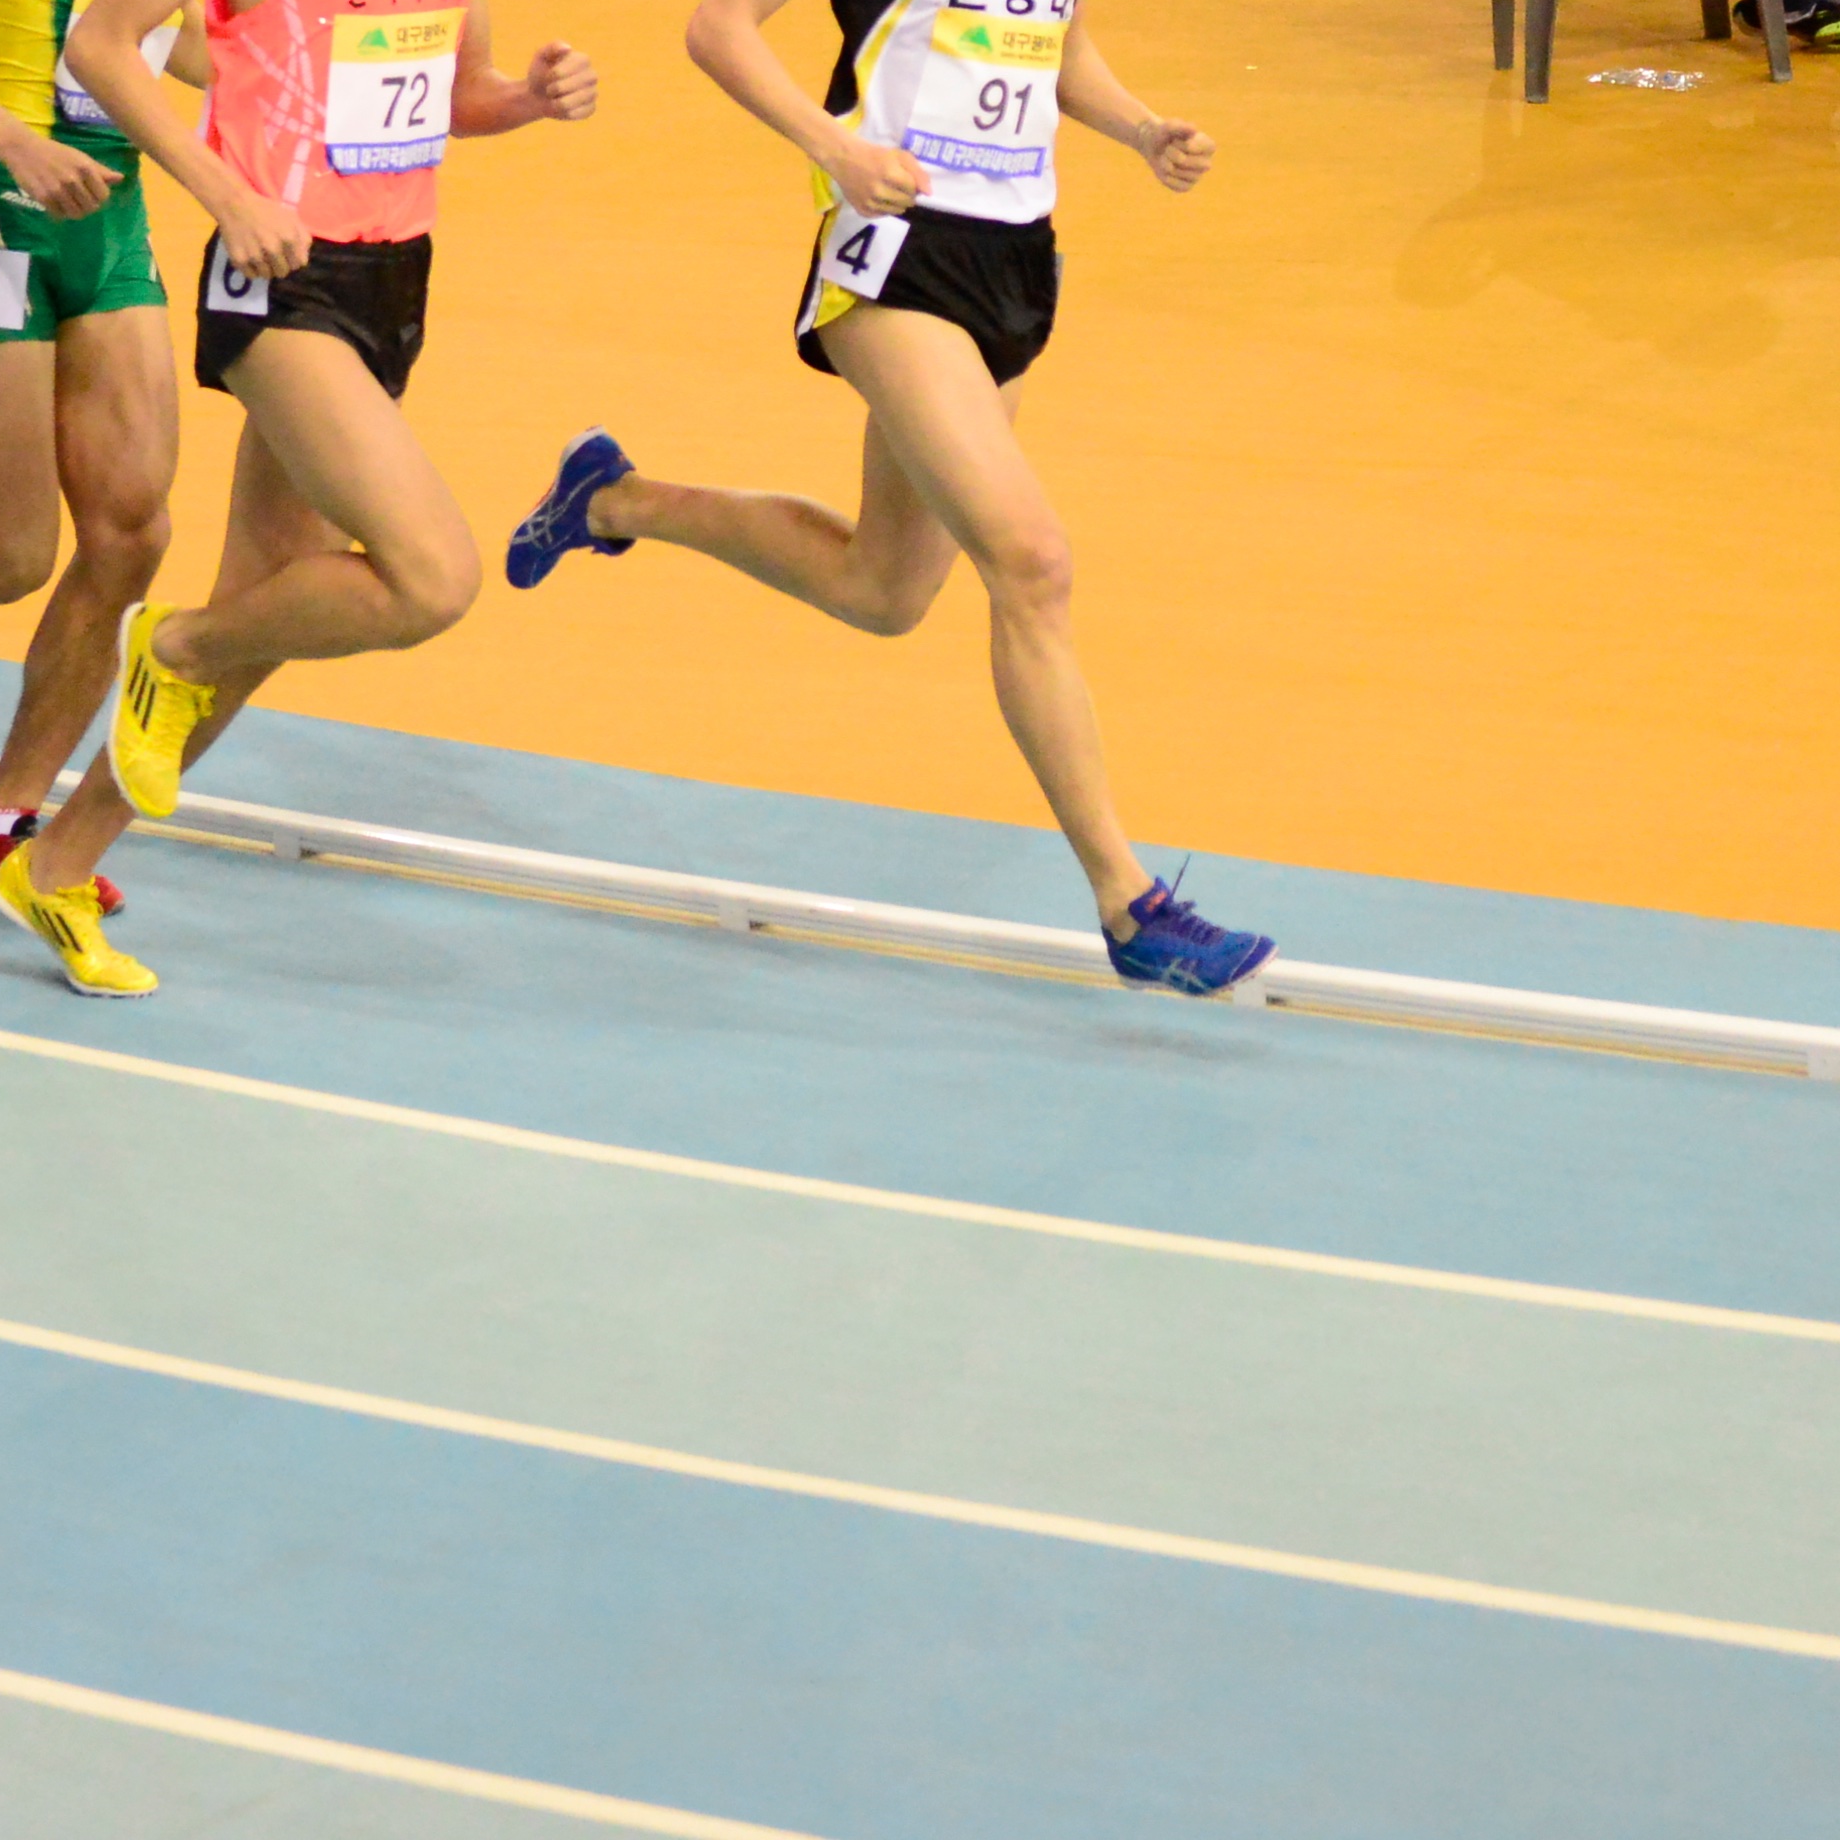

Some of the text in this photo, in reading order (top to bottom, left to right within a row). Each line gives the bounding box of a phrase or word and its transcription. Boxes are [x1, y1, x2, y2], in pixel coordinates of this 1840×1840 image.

[381, 71, 430, 130] 72
[973, 78, 1032, 135] 91
[836, 223, 878, 276] 4
